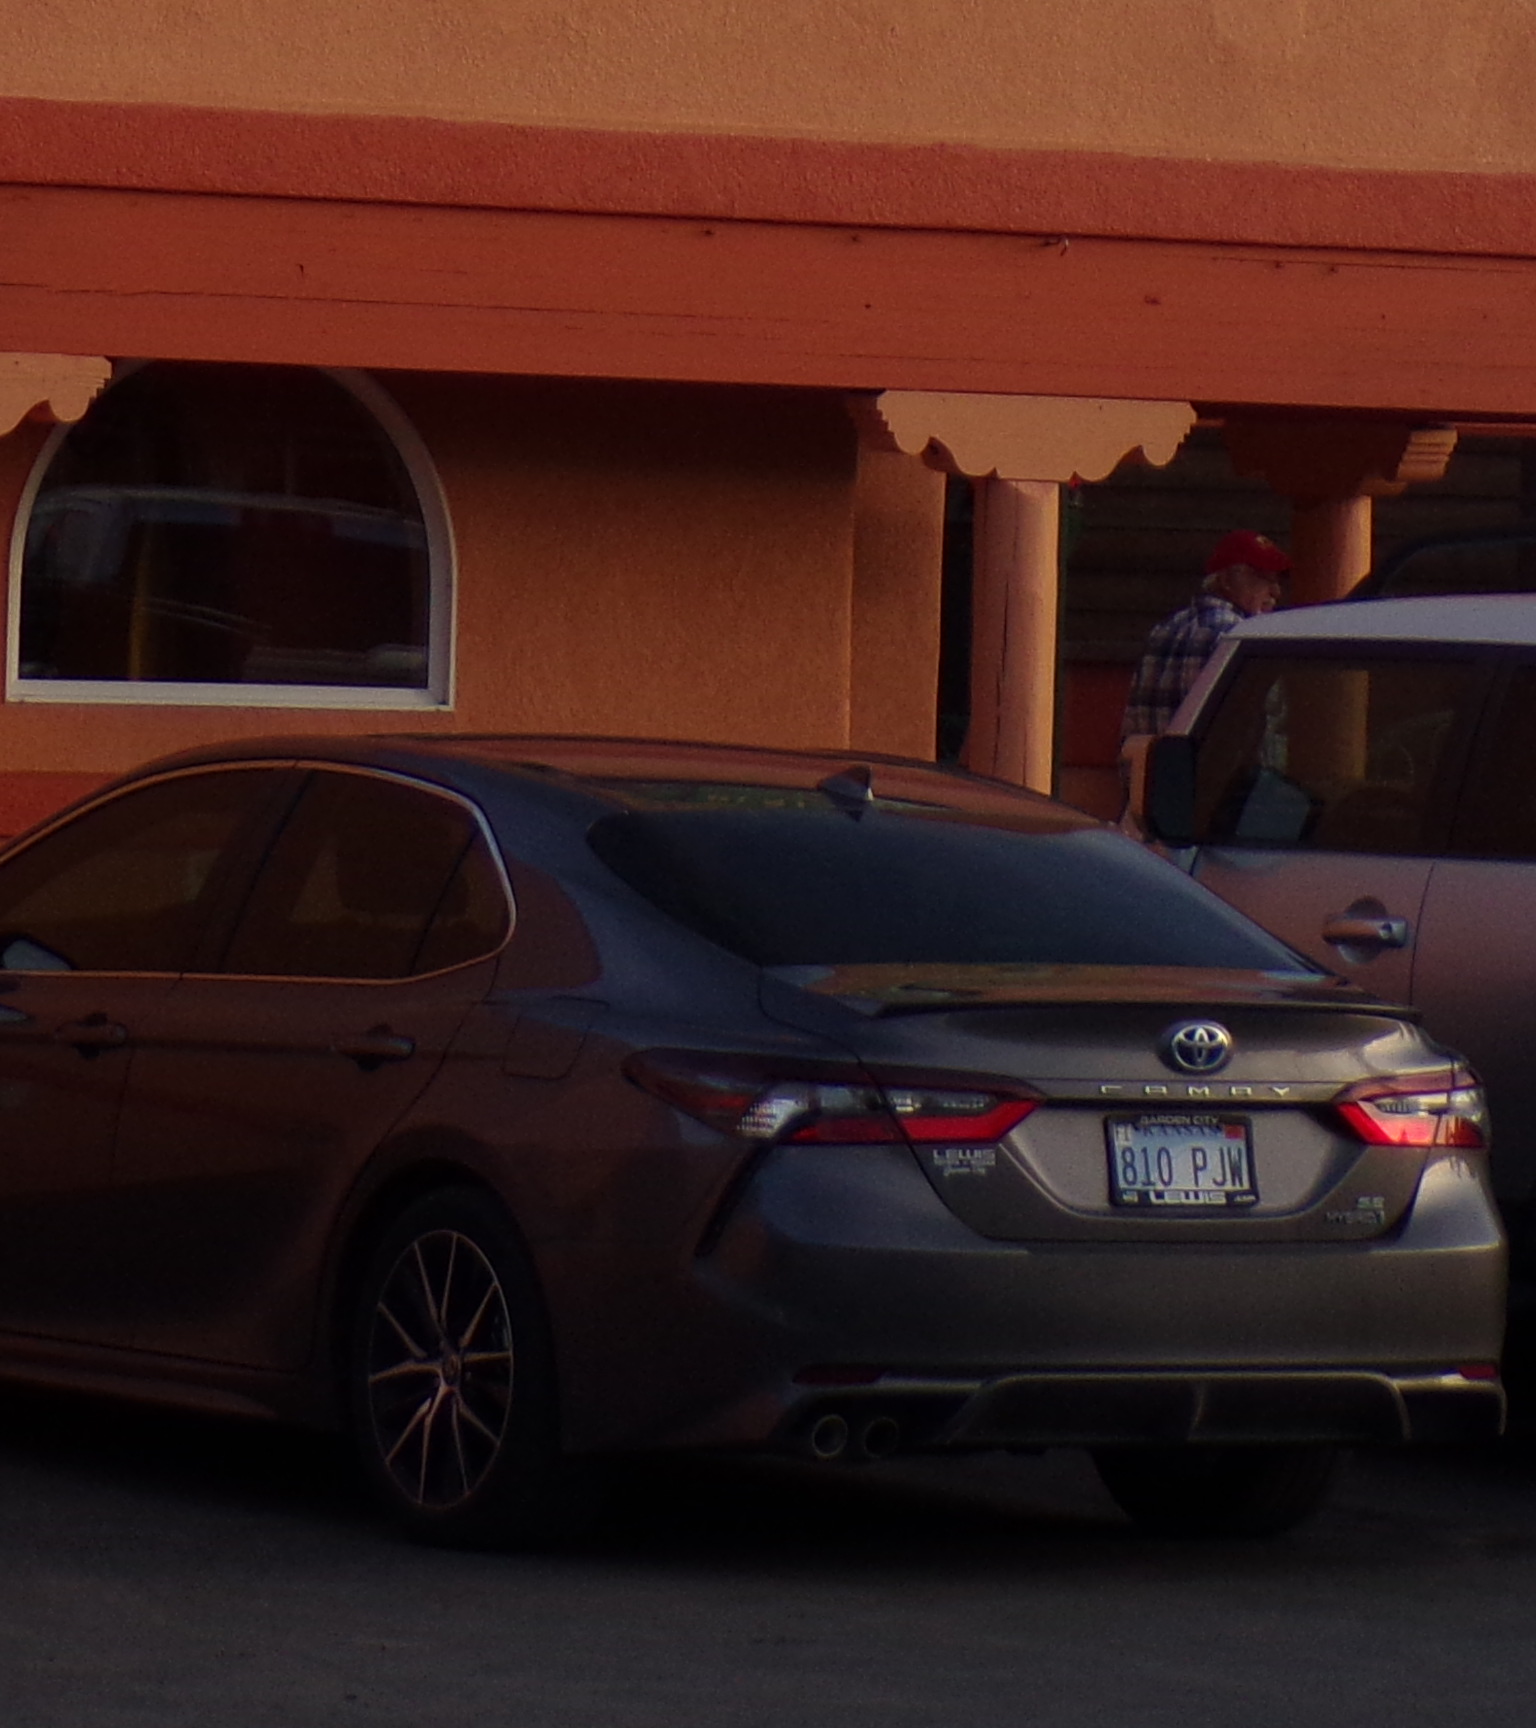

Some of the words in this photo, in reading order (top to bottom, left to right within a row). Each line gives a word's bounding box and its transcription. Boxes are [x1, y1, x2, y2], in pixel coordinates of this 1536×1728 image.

[1120, 1146, 1174, 1187] 810
[1190, 1146, 1245, 1188] PJW
[1149, 1189, 1227, 1205] LEWIS
